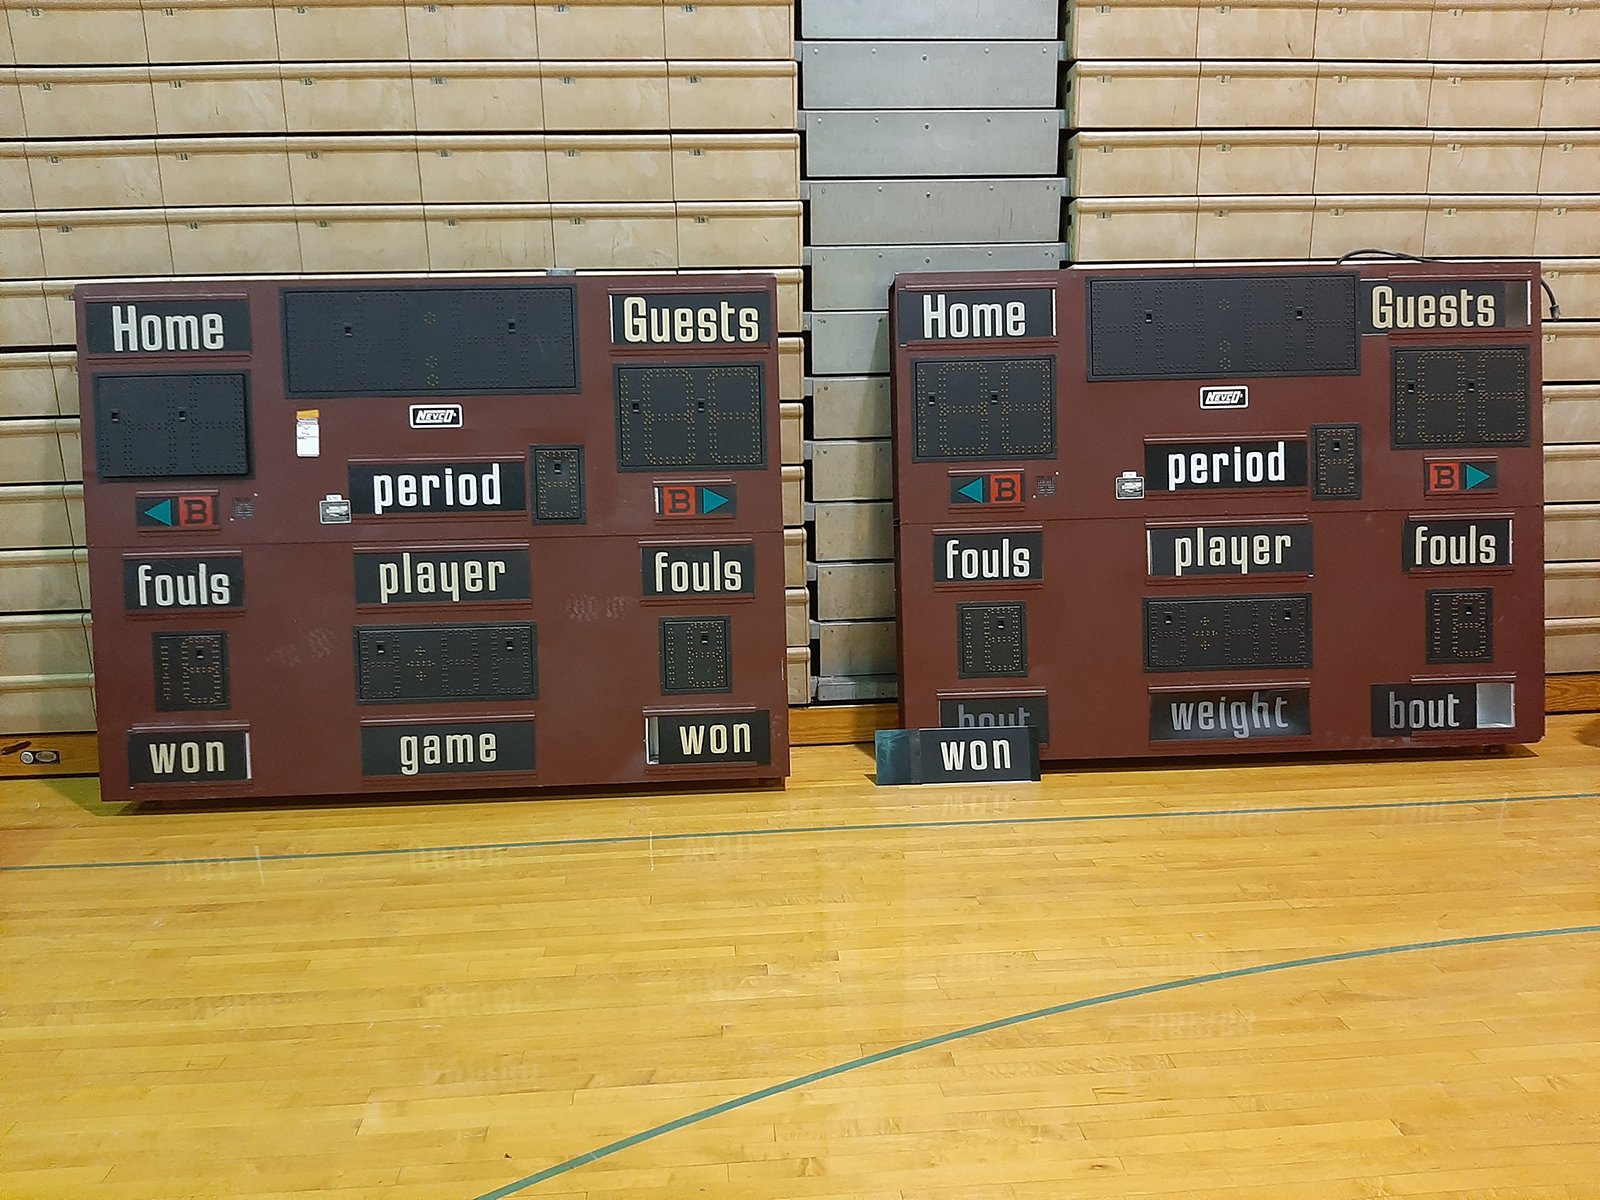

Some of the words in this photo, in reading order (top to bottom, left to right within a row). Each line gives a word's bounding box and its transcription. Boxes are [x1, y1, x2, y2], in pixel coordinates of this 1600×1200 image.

[166, 8, 173, 16] 14
[686, 4, 692, 12] 18
[623, 296, 759, 343] Guests
[923, 293, 1026, 339] Home
[1372, 285, 1495, 329] Guests
[112, 305, 224, 352] Home
[415, 409, 454, 423] NEVCO
[1205, 391, 1241, 404] NEVCO
[1168, 441, 1285, 492] period
[1434, 466, 1455, 489] B
[373, 462, 501, 515] period
[669, 489, 690, 513] B
[995, 477, 1016, 502] B
[184, 499, 208, 524] B
[946, 538, 1030, 579] fouls
[1174, 527, 1292, 577] player
[1415, 525, 1496, 565] fouls
[138, 563, 230, 607] fouls
[379, 552, 506, 604] player
[655, 550, 742, 592] fouls
[1170, 692, 1289, 739] weight
[1389, 691, 1460, 729] bout
[149, 741, 225, 774] won
[400, 733, 497, 775] game
[679, 723, 751, 755] won
[940, 739, 1011, 771] won
